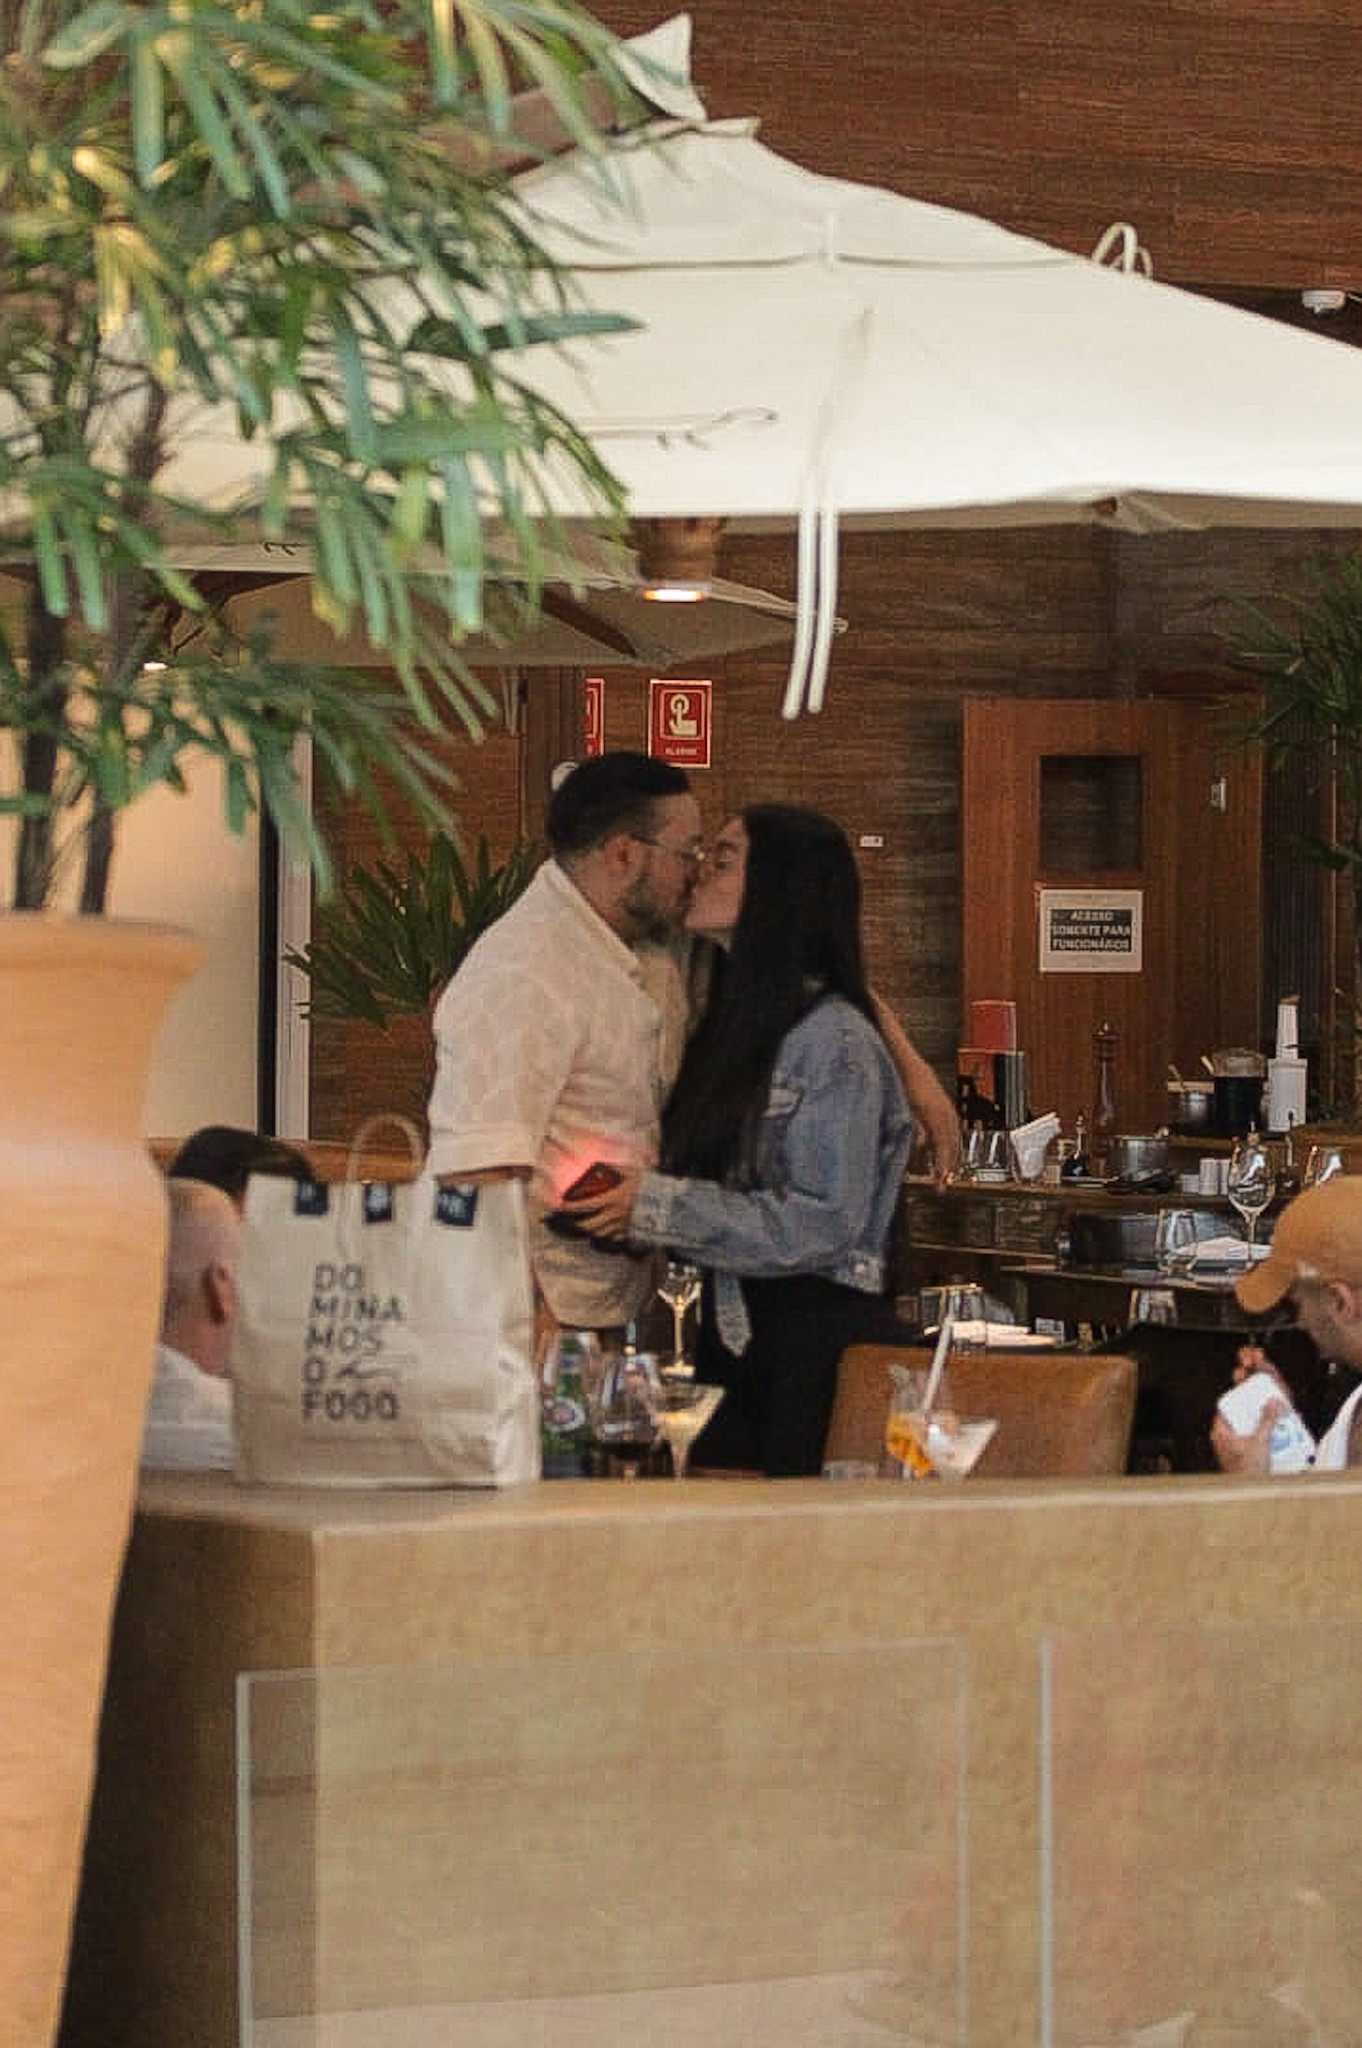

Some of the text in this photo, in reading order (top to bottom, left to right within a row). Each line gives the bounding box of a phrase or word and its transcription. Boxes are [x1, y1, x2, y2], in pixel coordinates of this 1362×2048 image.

[314, 1264, 364, 1291] DO
[309, 1296, 403, 1321] MINA
[304, 1325, 383, 1355] MOS
